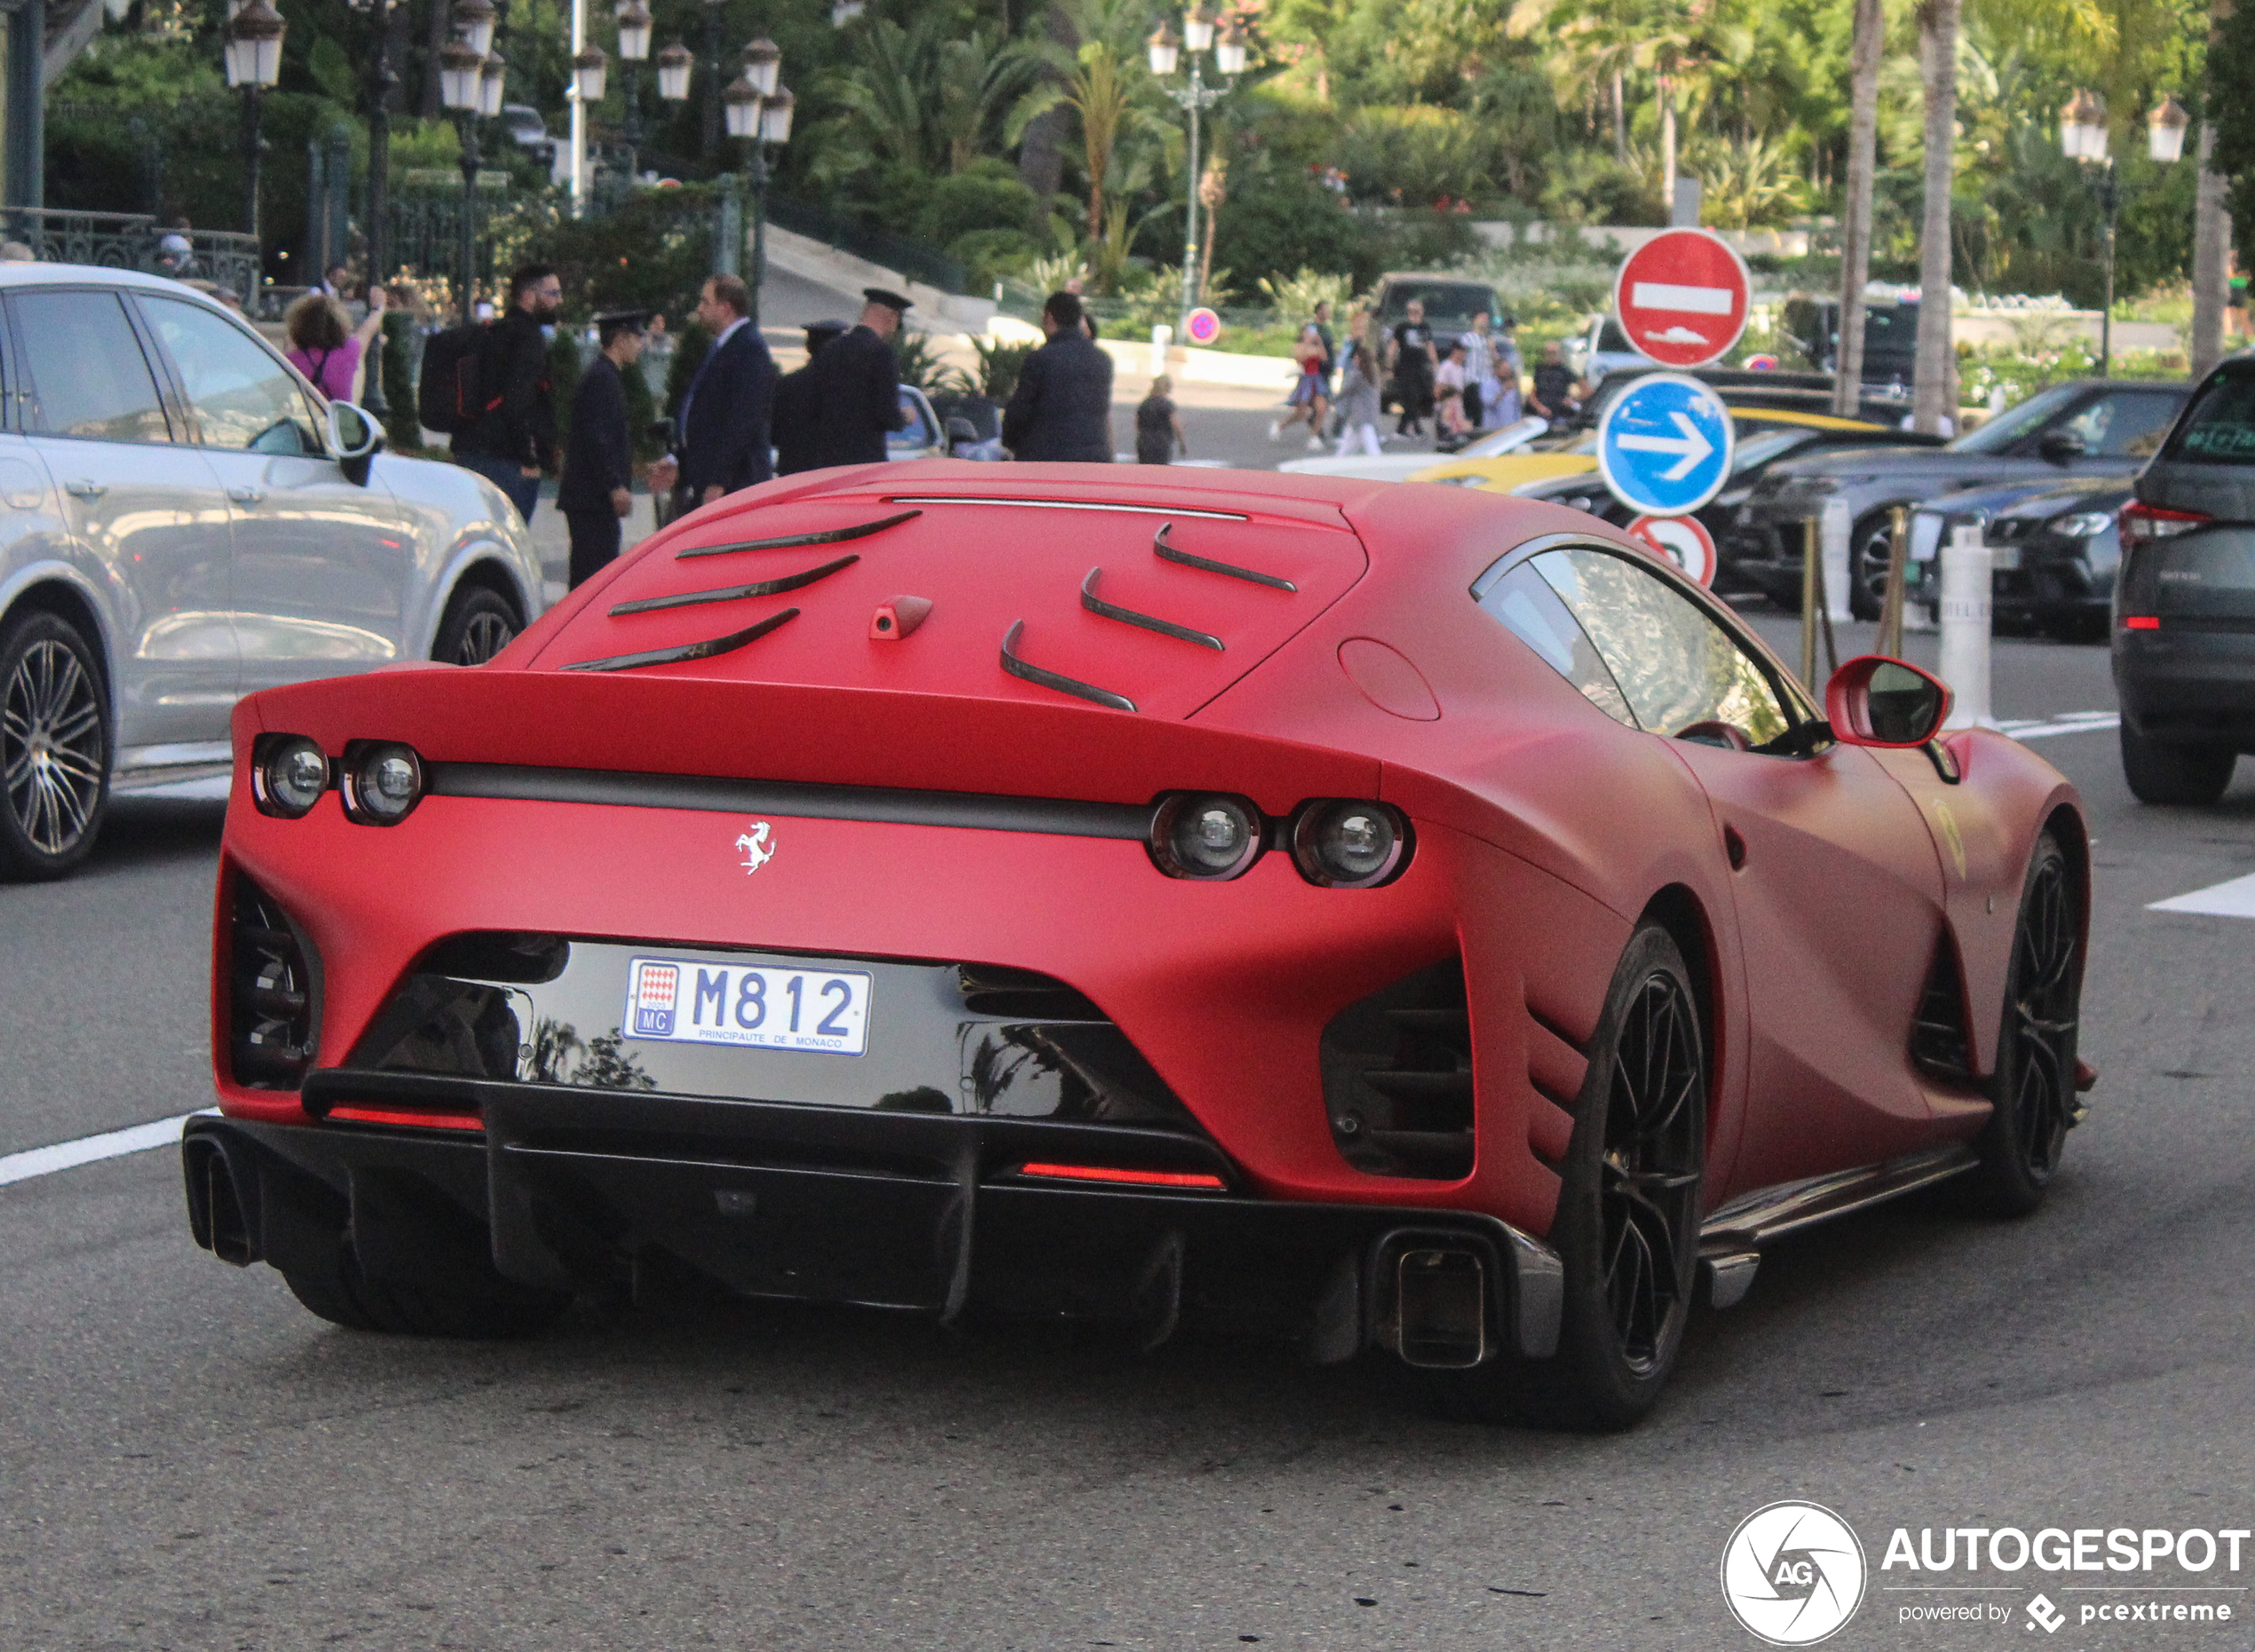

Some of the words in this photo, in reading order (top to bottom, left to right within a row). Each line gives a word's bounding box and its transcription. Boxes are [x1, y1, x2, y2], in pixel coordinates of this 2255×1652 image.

[692, 968, 852, 1037] M812
[643, 1010, 667, 1031] MC
[699, 1029, 765, 1043] PRINCIPAUTE
[774, 1035, 787, 1044] DE
[795, 1037, 843, 1048] MONACO
